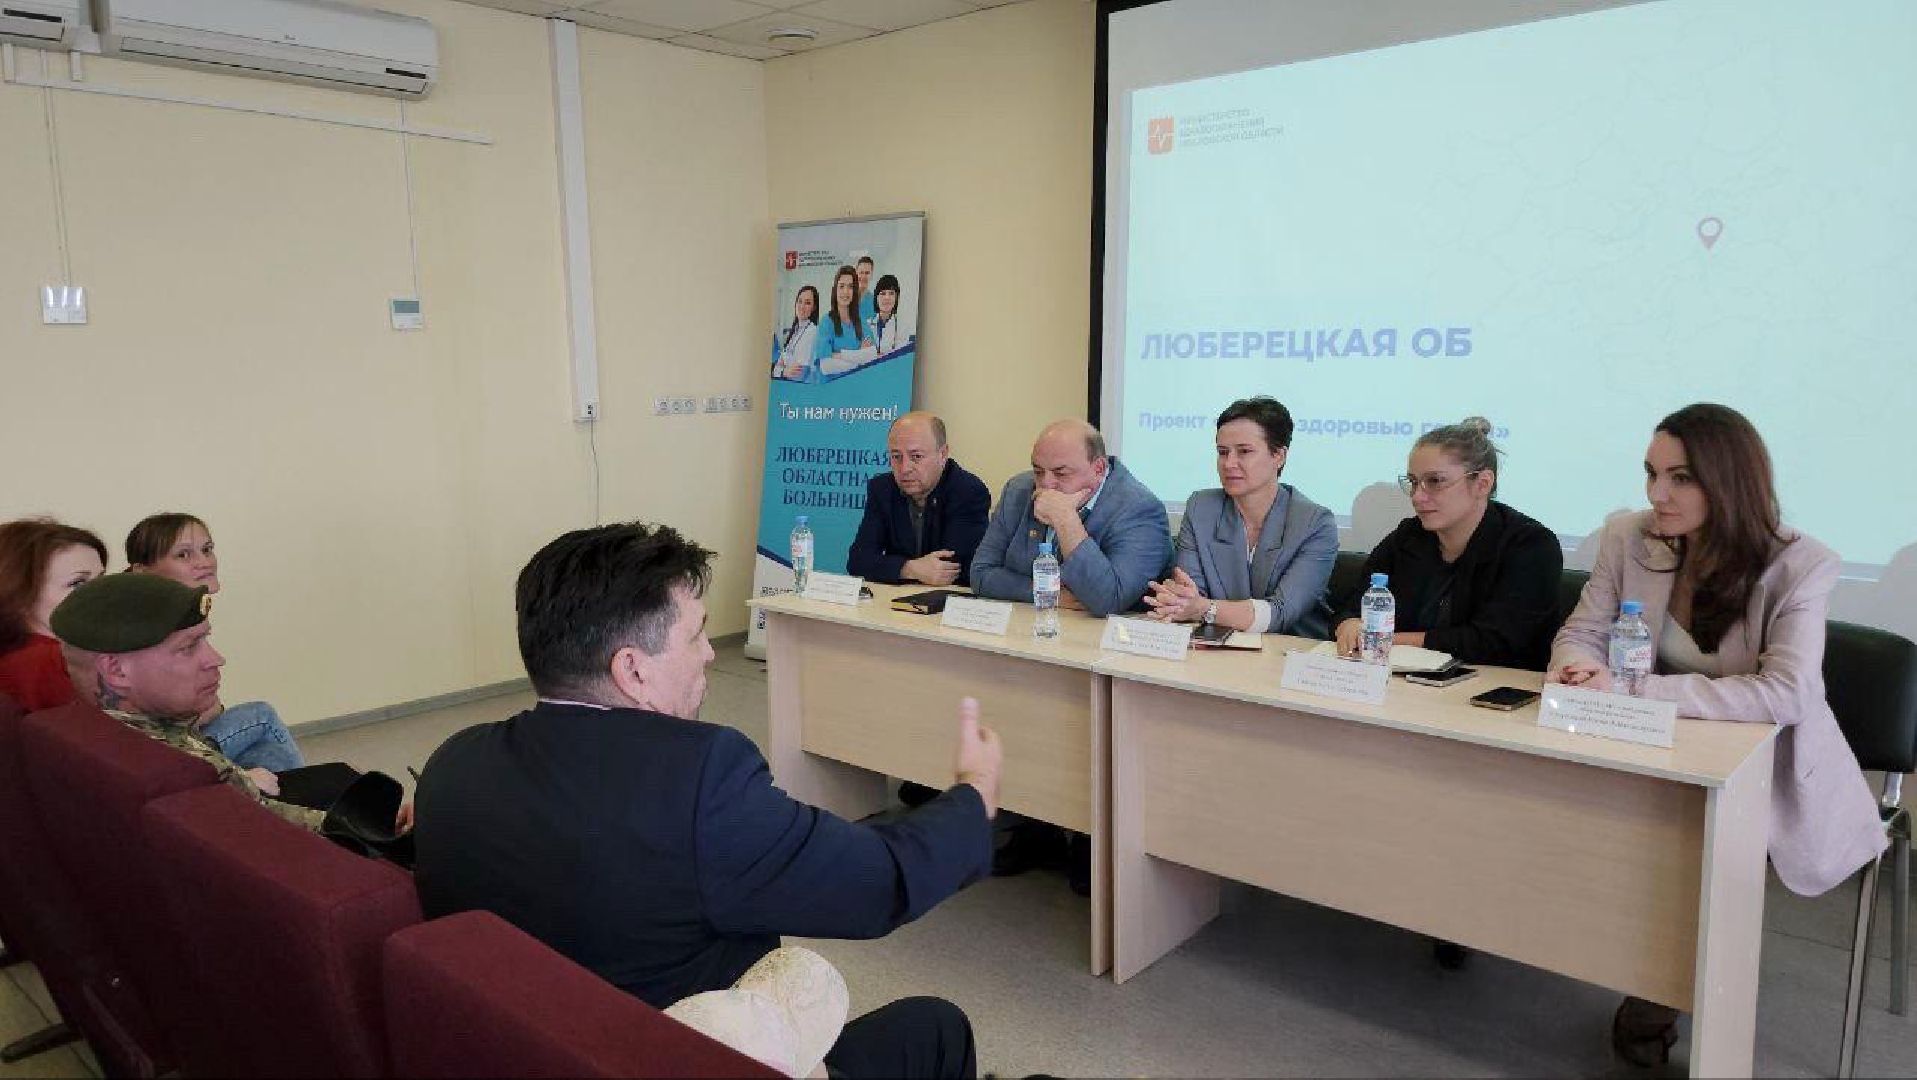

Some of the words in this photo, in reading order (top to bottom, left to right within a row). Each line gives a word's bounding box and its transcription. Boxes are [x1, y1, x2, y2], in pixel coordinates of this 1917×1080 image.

[1141, 328, 1398, 362] ЛЮБЕРЕЦКАЯ
[1411, 327, 1474, 359] ОБ
[780, 402, 799, 420] Ты
[804, 406, 835, 420] нам
[839, 404, 898, 424] нужен!
[1138, 412, 1208, 431] Проект
[1297, 419, 1414, 437] здоровью
[776, 446, 892, 468] ЛЮБЕРЕЦКАЯ
[782, 467, 868, 487] ОБЛАСТНА
[783, 489, 866, 510] БОЛЬНИЦ
